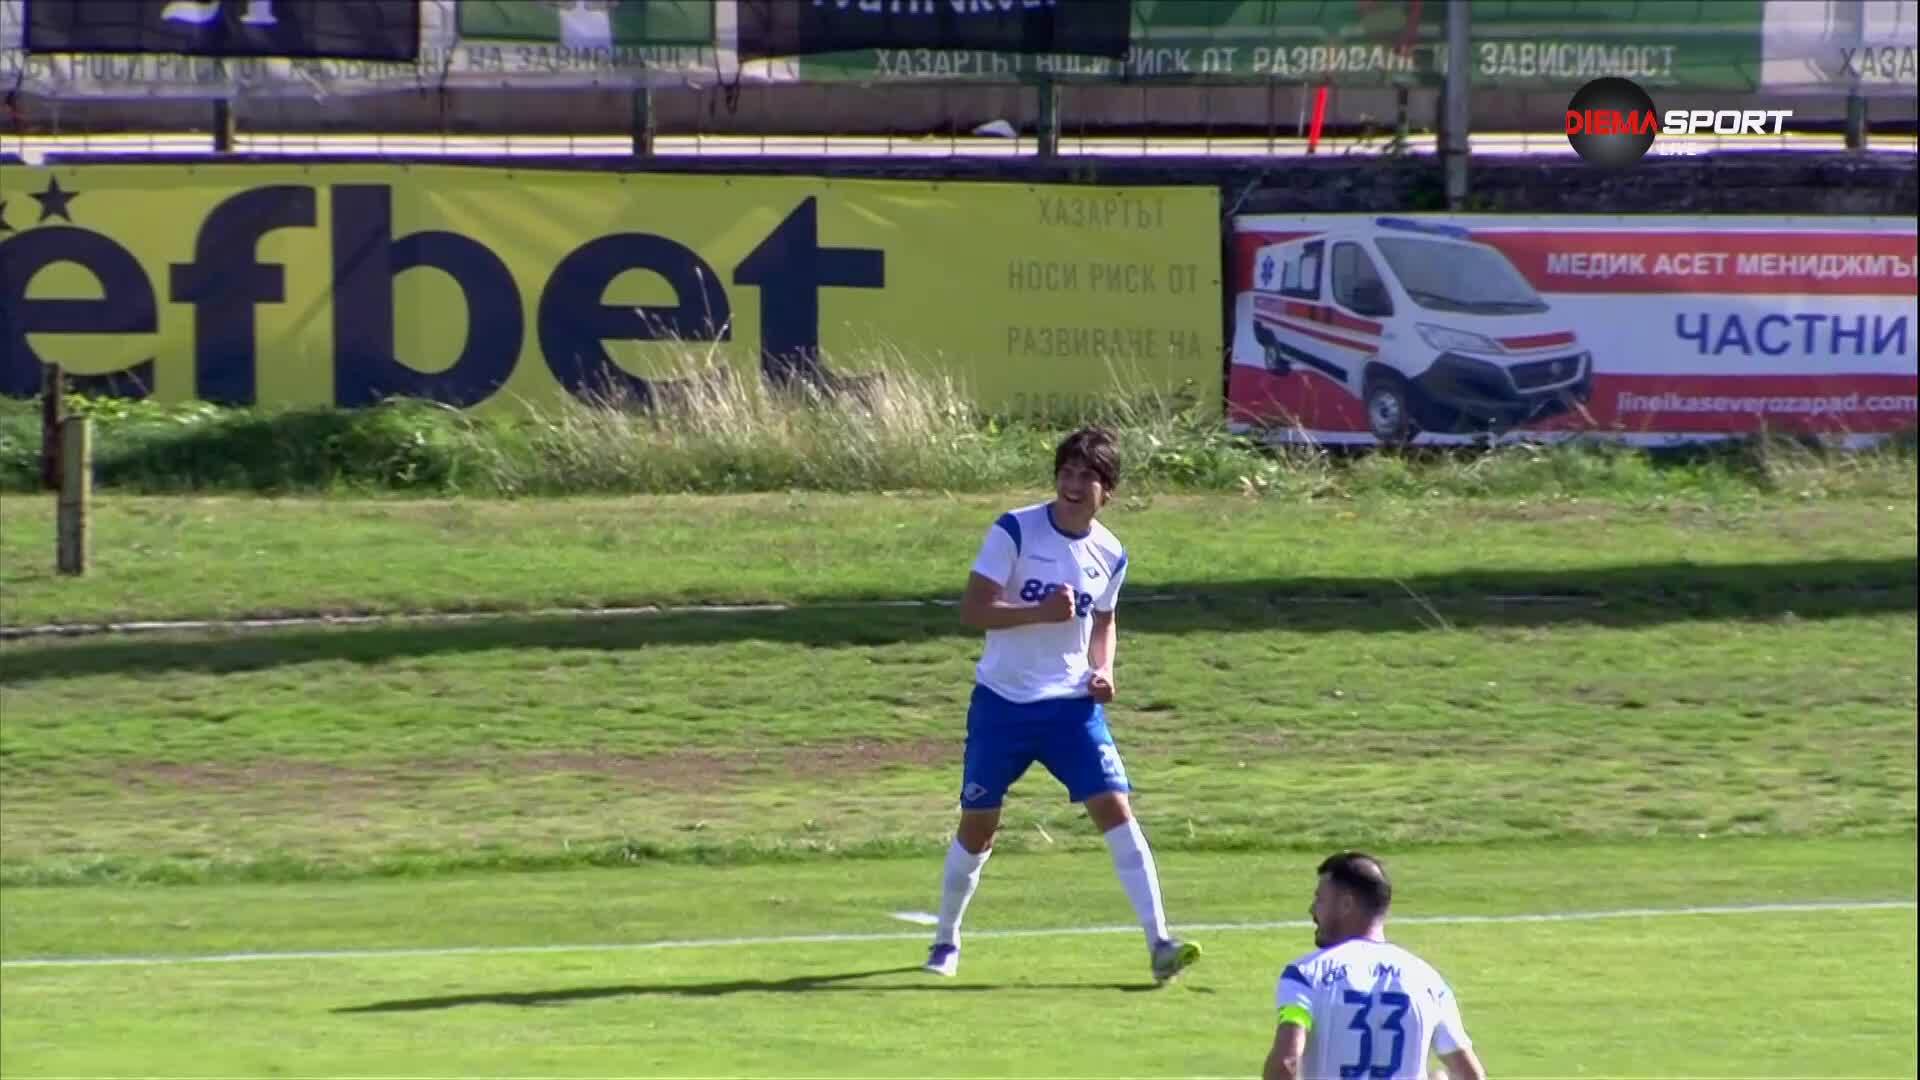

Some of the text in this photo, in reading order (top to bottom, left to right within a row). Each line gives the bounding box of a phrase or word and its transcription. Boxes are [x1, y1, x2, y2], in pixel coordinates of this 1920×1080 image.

[1202, 47, 1238, 73] ОТ
[1479, 43, 1678, 78] ЗАВИСИМОСТ
[1038, 197, 1167, 230] ХАЗАРТЪТ
[1008, 260, 1199, 294] НОСИ РИСК ОТ
[1546, 252, 1648, 280] МЕДИК
[1653, 252, 1729, 277] АСЕТ
[0, 183, 885, 408] efbet
[1008, 326, 1203, 361] РАЗВИВАНЕ НА
[1675, 313, 1910, 356] ЧАСТНИ
[1339, 989, 1411, 1079] 33
